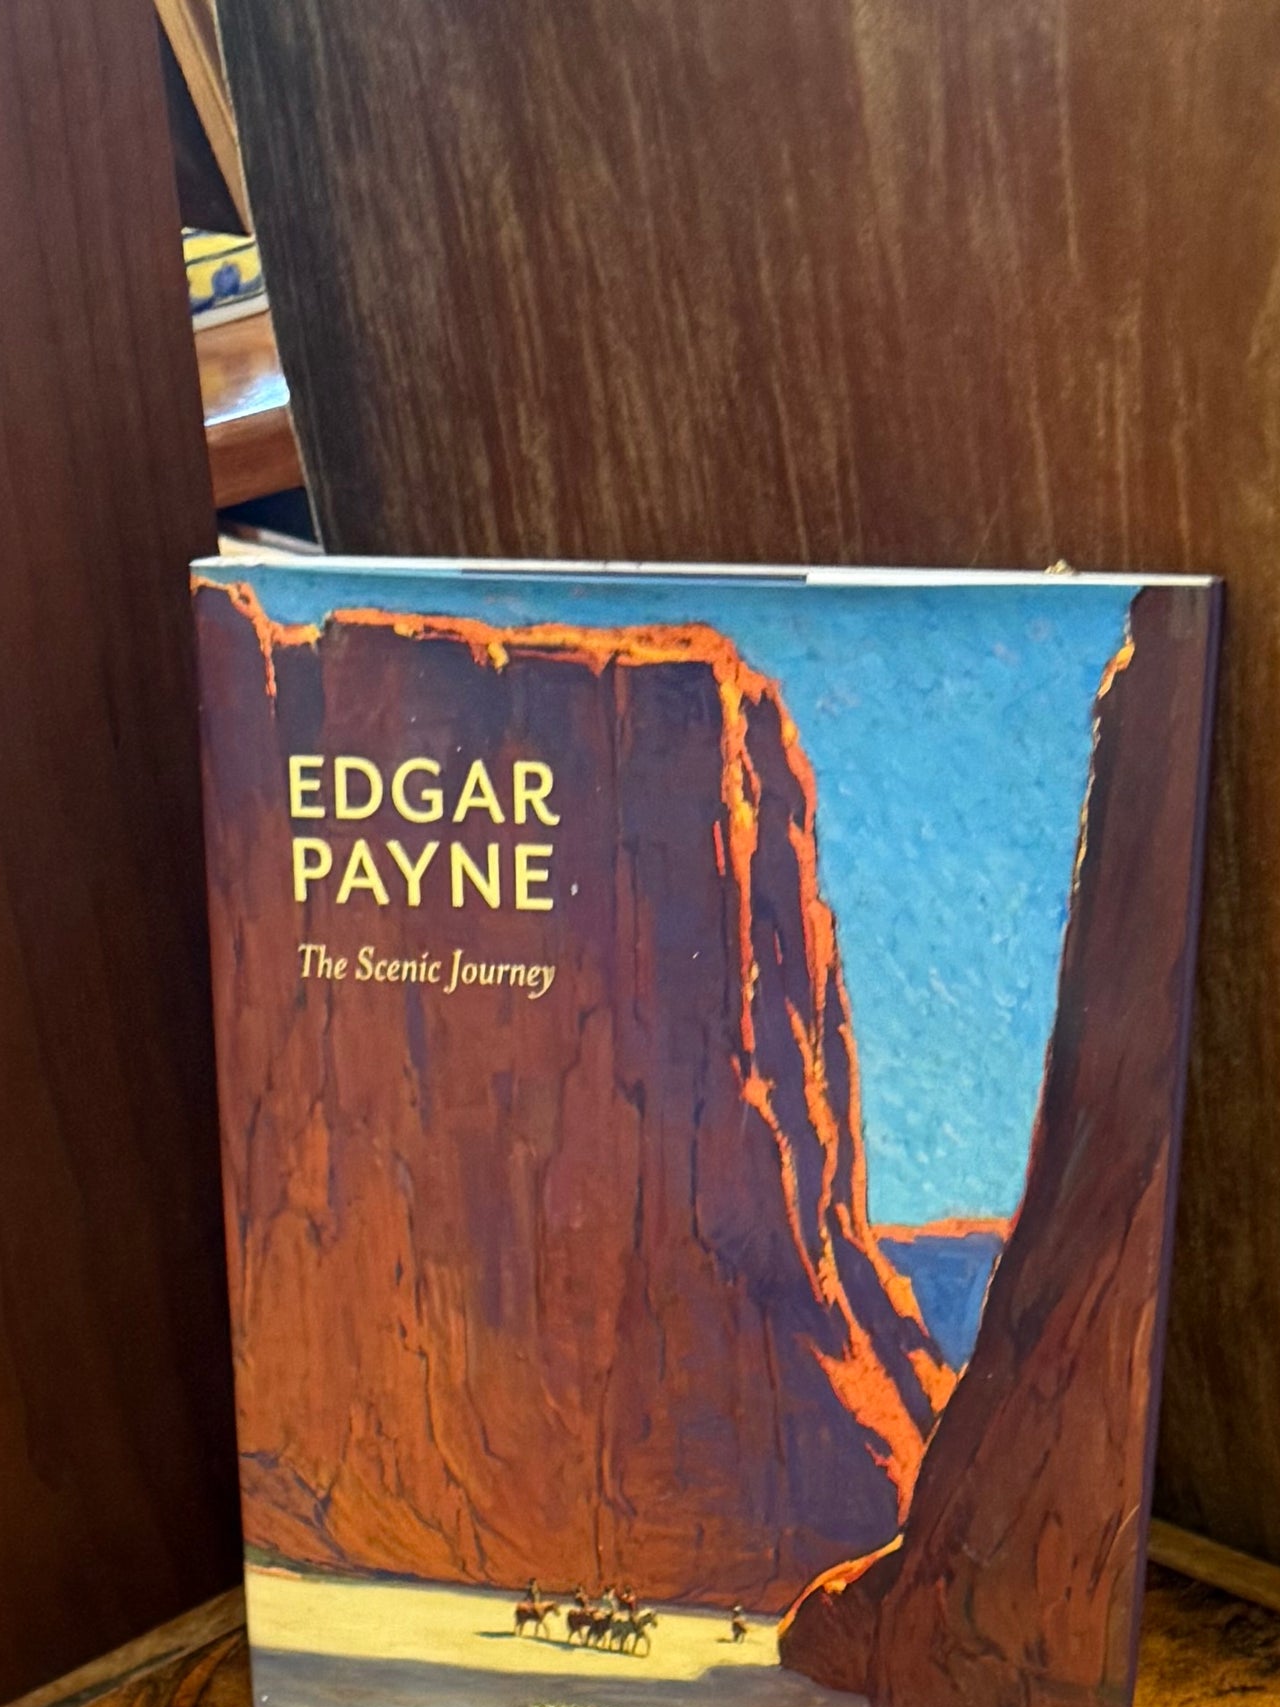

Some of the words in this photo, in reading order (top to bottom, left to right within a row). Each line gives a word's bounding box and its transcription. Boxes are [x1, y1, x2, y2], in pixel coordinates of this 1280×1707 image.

[289, 755, 560, 826] EDGAR
[293, 837, 554, 911] PAYNE
[298, 943, 348, 980] The
[355, 945, 440, 983] Scenic
[443, 949, 556, 1000] Journey
